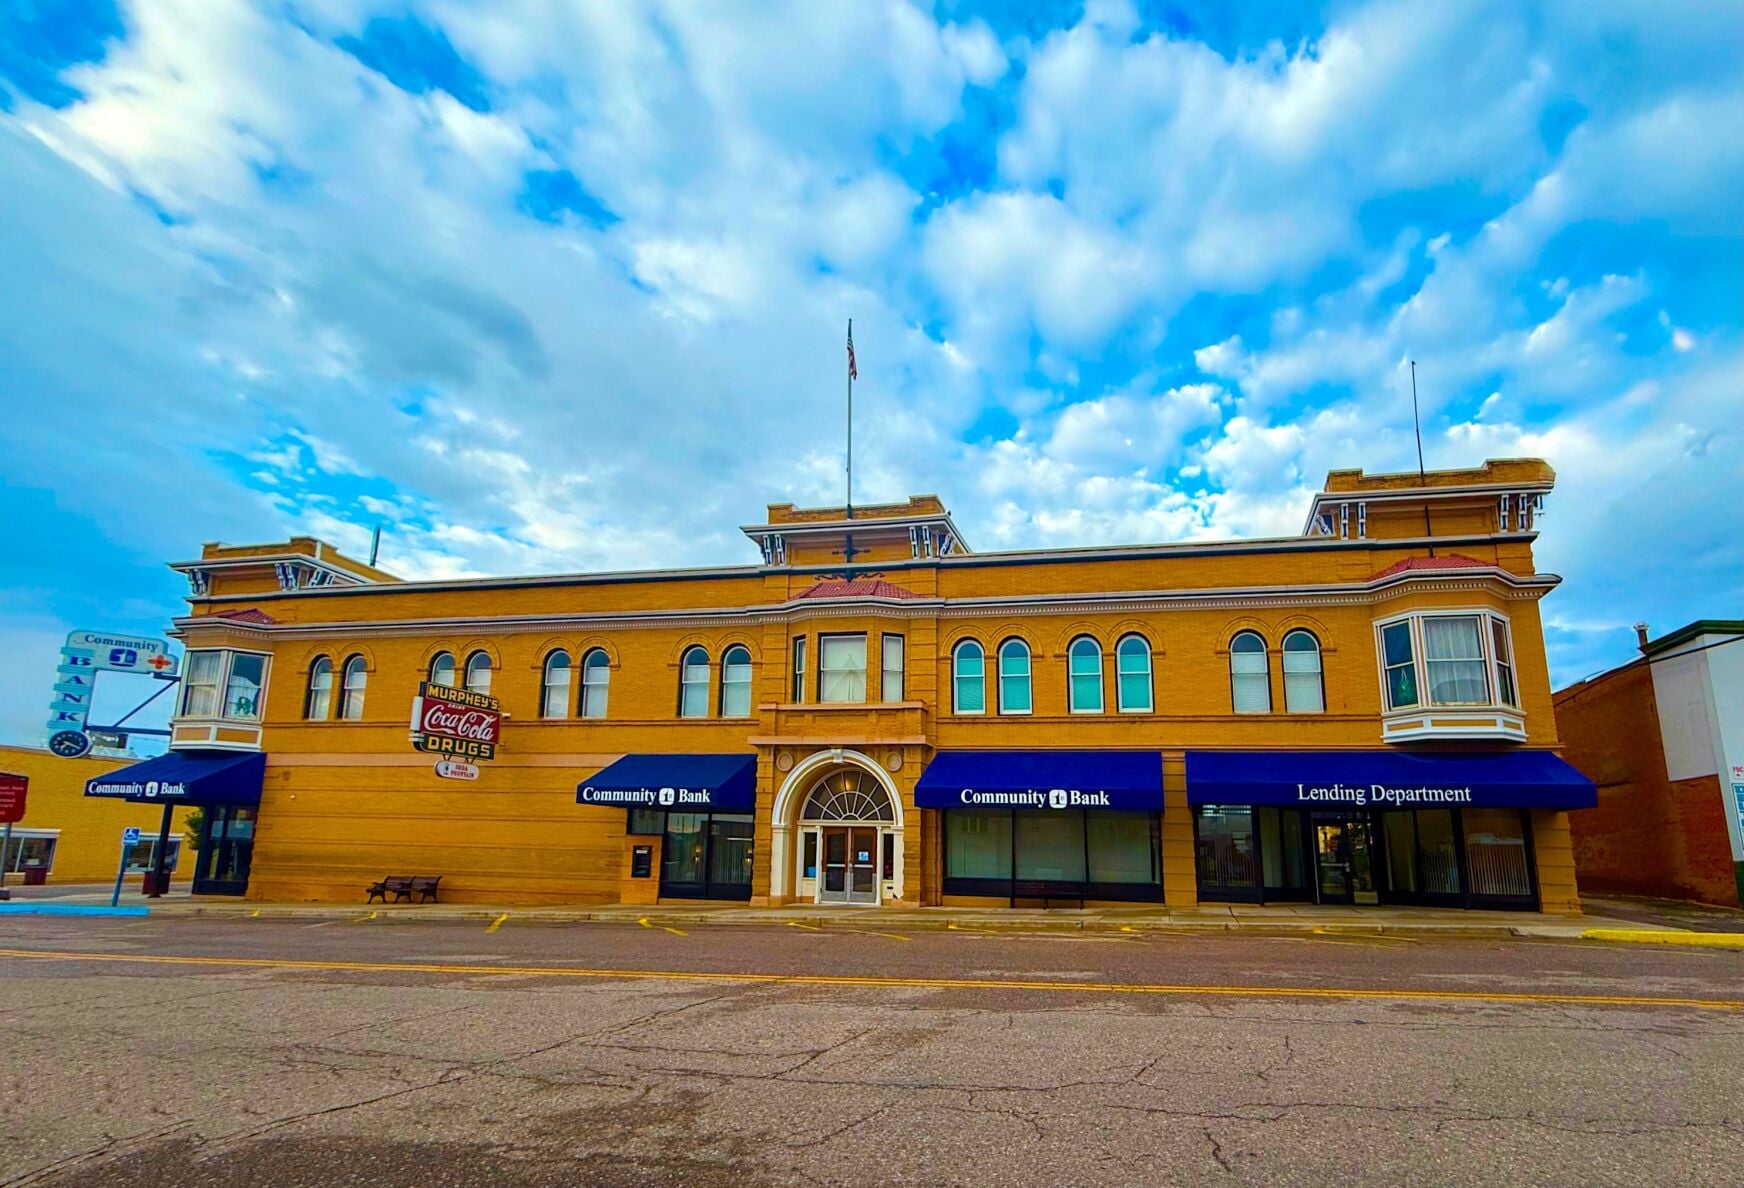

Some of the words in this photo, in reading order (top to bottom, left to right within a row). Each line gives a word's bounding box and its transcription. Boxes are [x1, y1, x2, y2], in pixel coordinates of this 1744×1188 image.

[84, 634, 158, 652] Community
[57, 655, 92, 721] BANK
[428, 685, 498, 709] MURPHEY'S
[428, 736, 490, 757] DRUGS
[88, 781, 144, 797] Community
[160, 782, 185, 795] Bank
[582, 786, 657, 806] Community
[678, 788, 711, 803] Bank
[960, 788, 1047, 808] Community
[1069, 790, 1110, 805] Bank
[1297, 783, 1366, 806] Lending
[1370, 784, 1472, 806] Department
